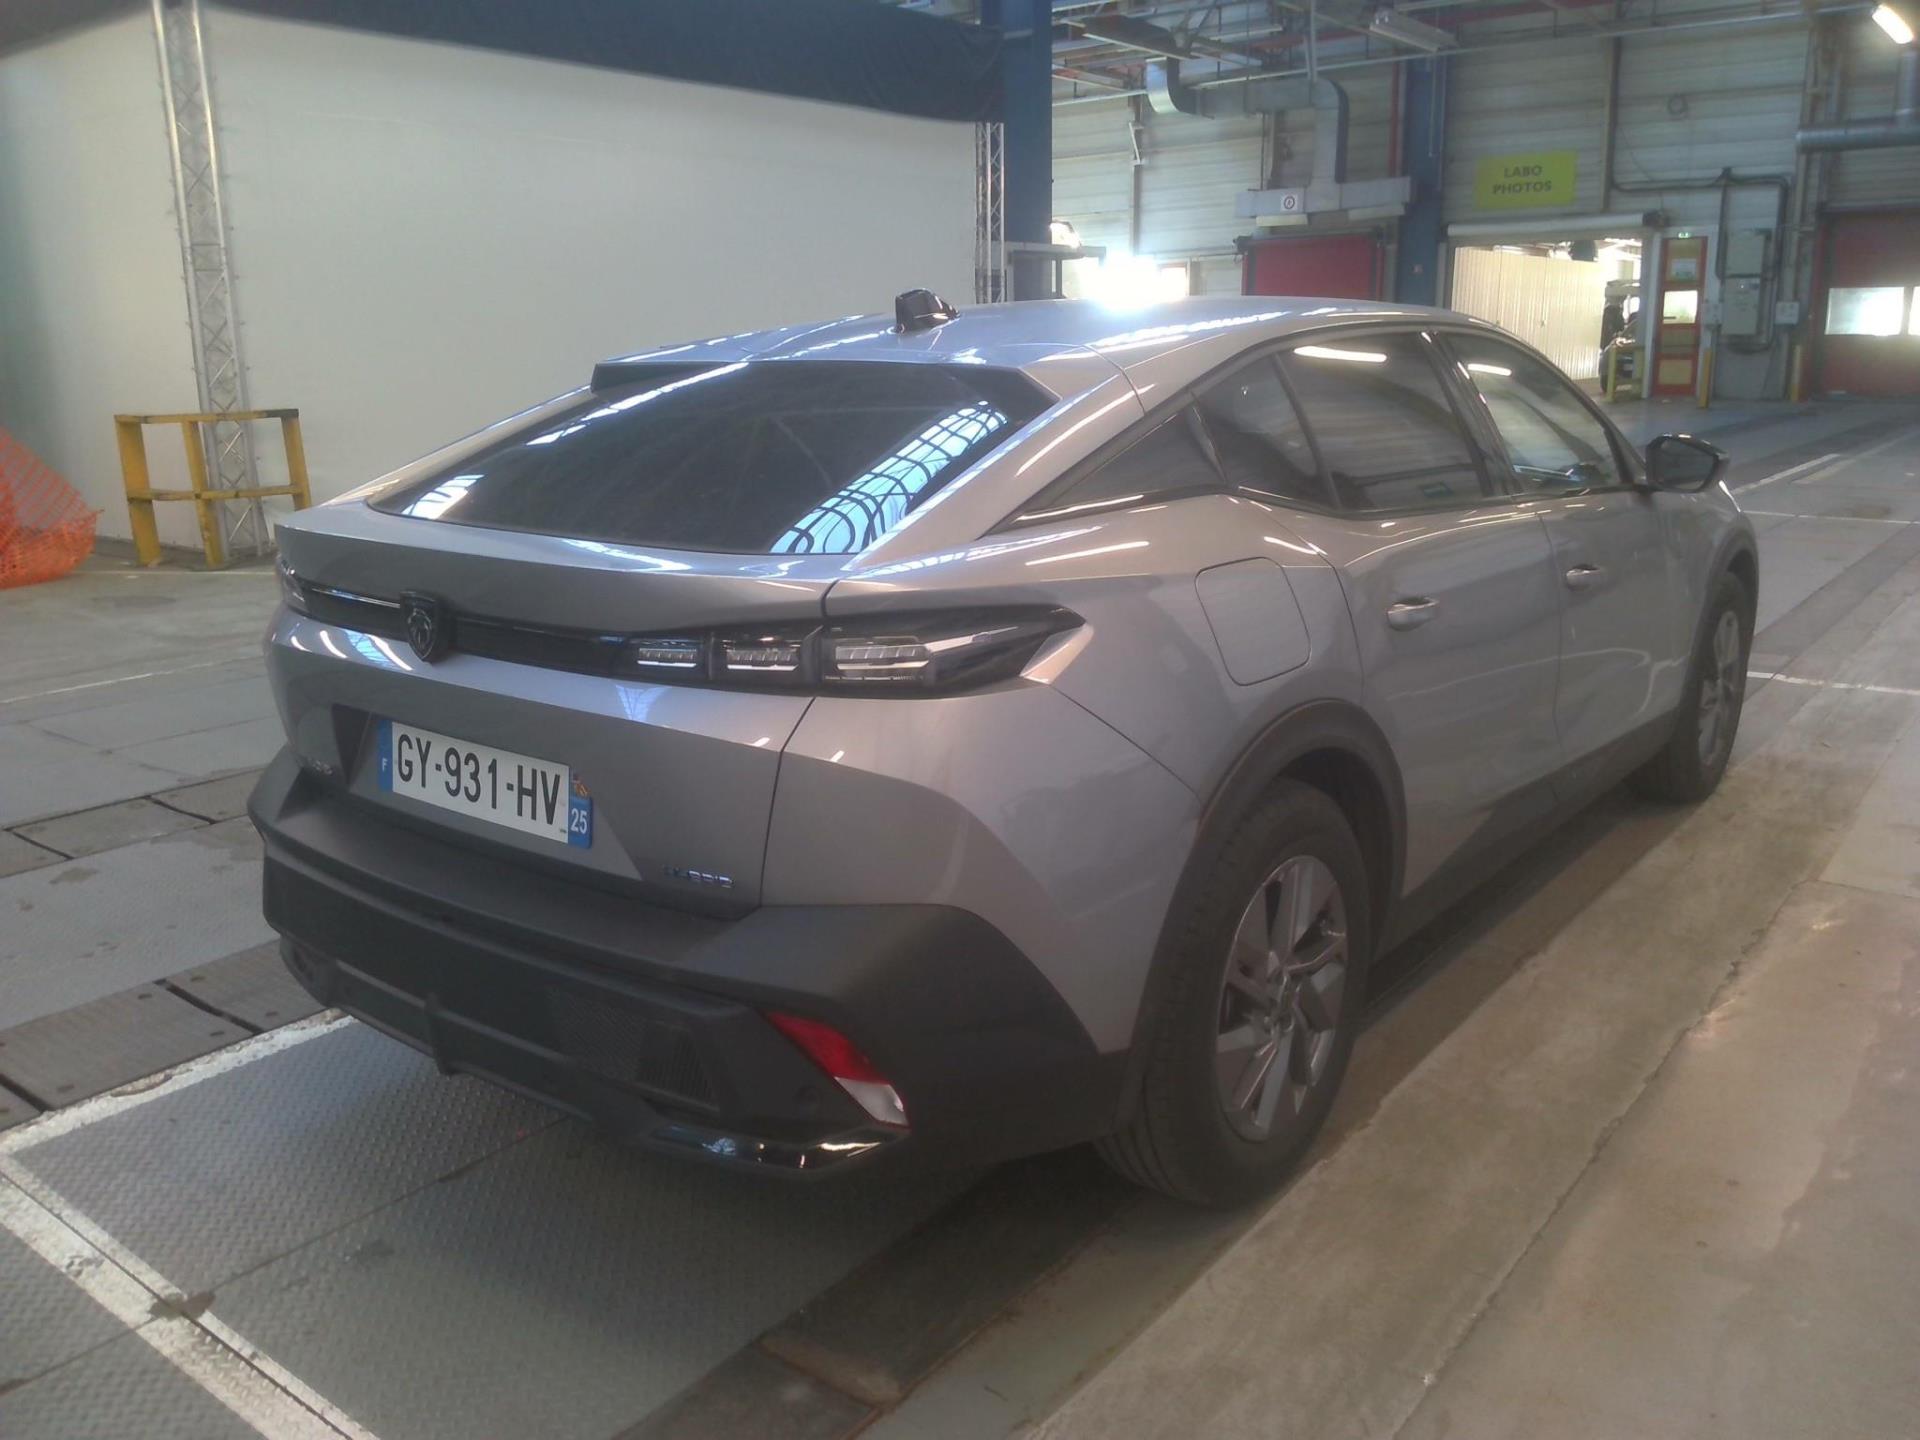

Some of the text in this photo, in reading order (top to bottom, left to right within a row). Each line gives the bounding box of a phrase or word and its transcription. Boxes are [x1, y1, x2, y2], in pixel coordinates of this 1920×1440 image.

[1503, 165, 1544, 178] LABO
[1492, 180, 1553, 195] PHOTOS
[382, 757, 389, 773] F
[397, 733, 561, 826] GY-931-HV
[571, 807, 588, 835] 25
